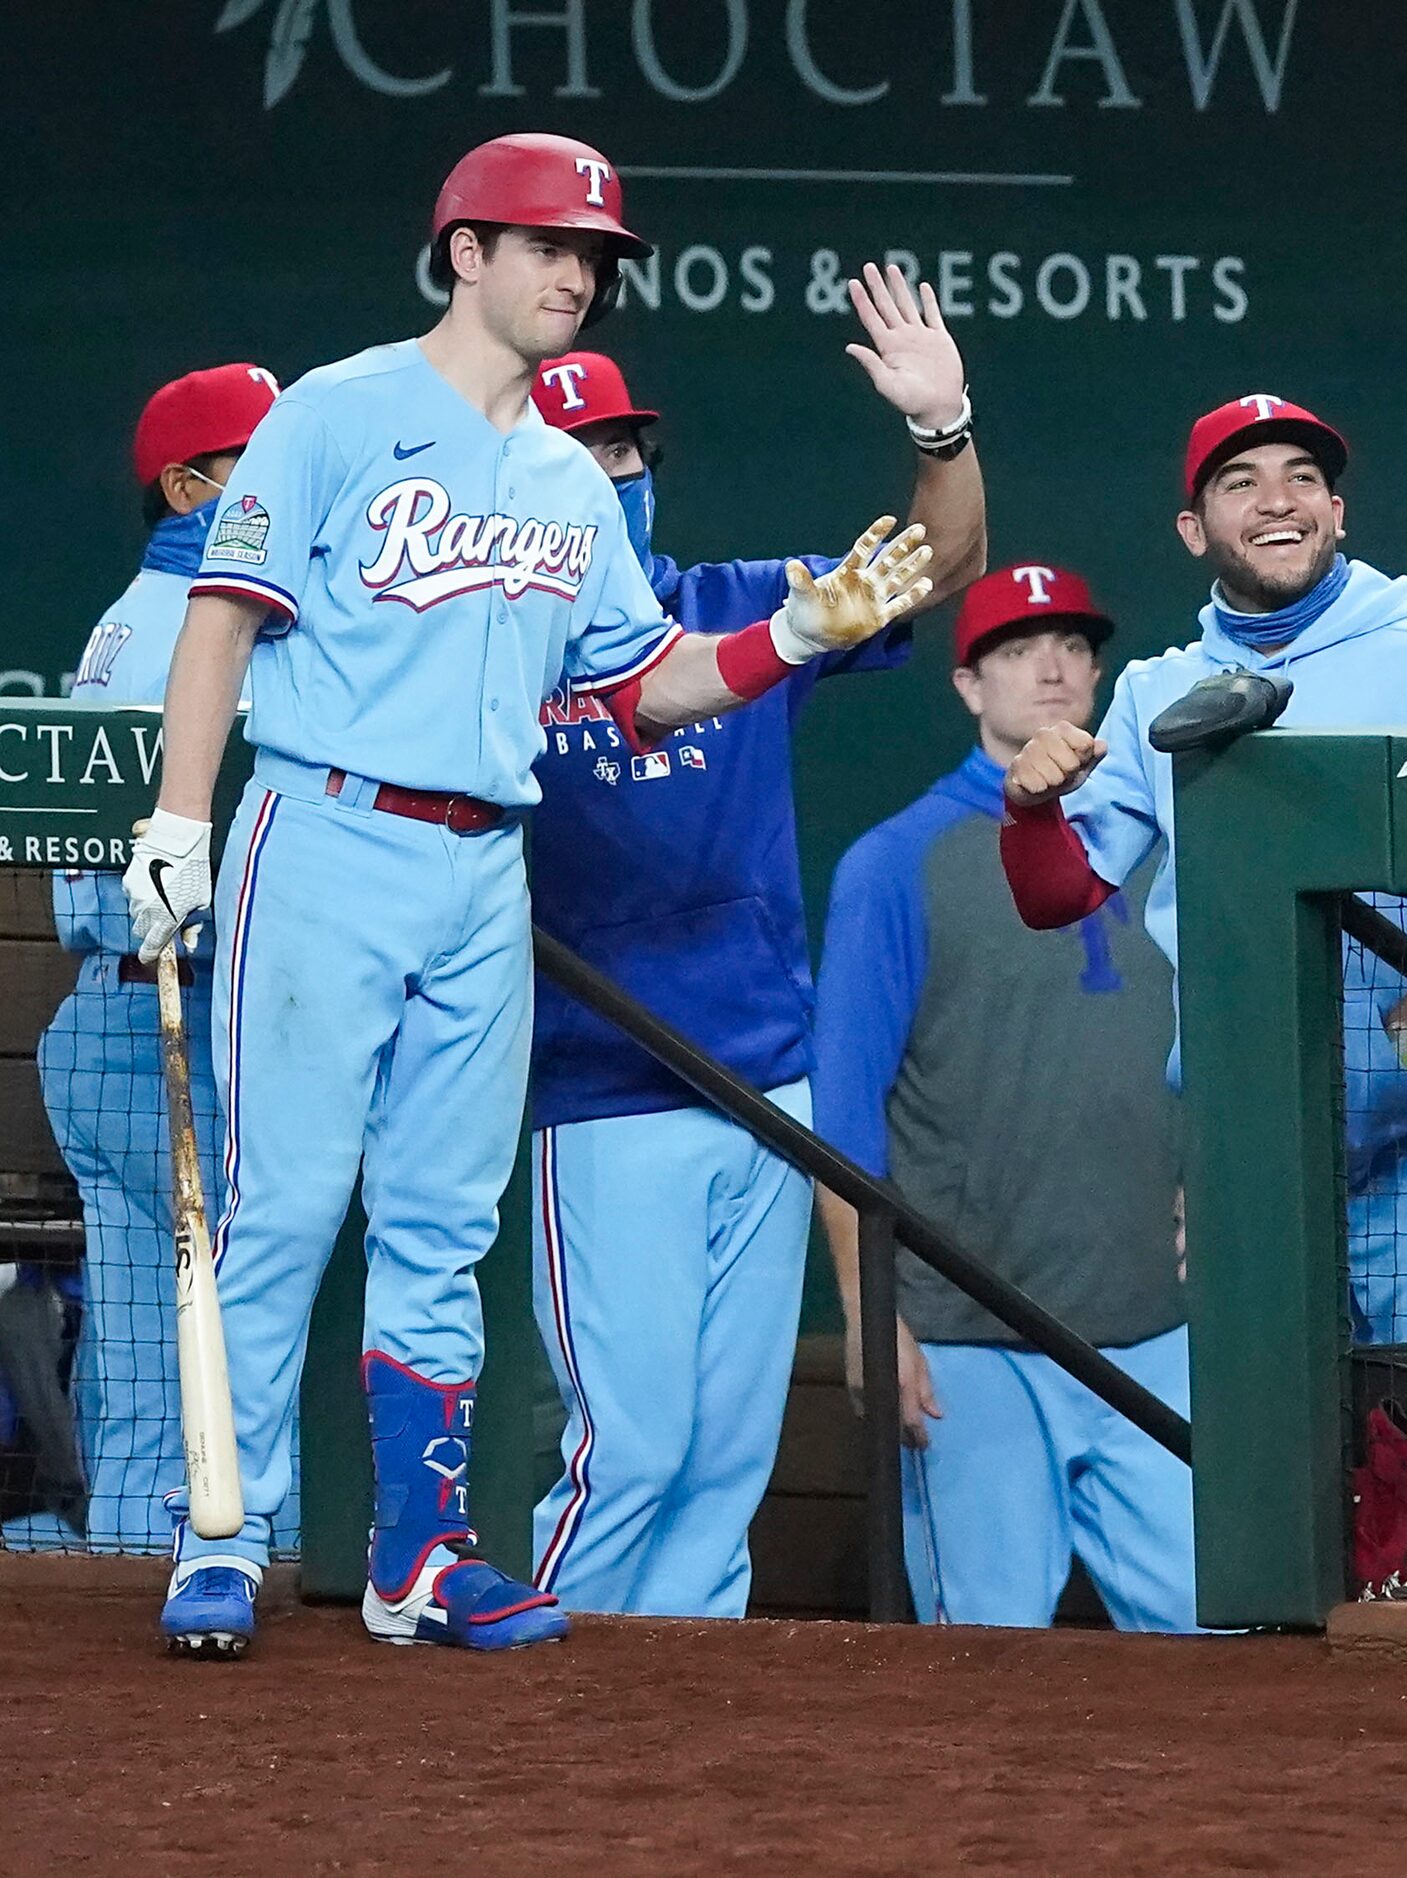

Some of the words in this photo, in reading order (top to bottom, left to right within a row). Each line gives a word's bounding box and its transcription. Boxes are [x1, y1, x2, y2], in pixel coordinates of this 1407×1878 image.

[576, 157, 611, 208] T
[541, 363, 588, 411] T
[1239, 393, 1284, 421] T
[358, 477, 598, 603] Rangers
[1012, 566, 1056, 604] T
[459, 1398, 475, 1428] T
[455, 1485, 469, 1515] T
